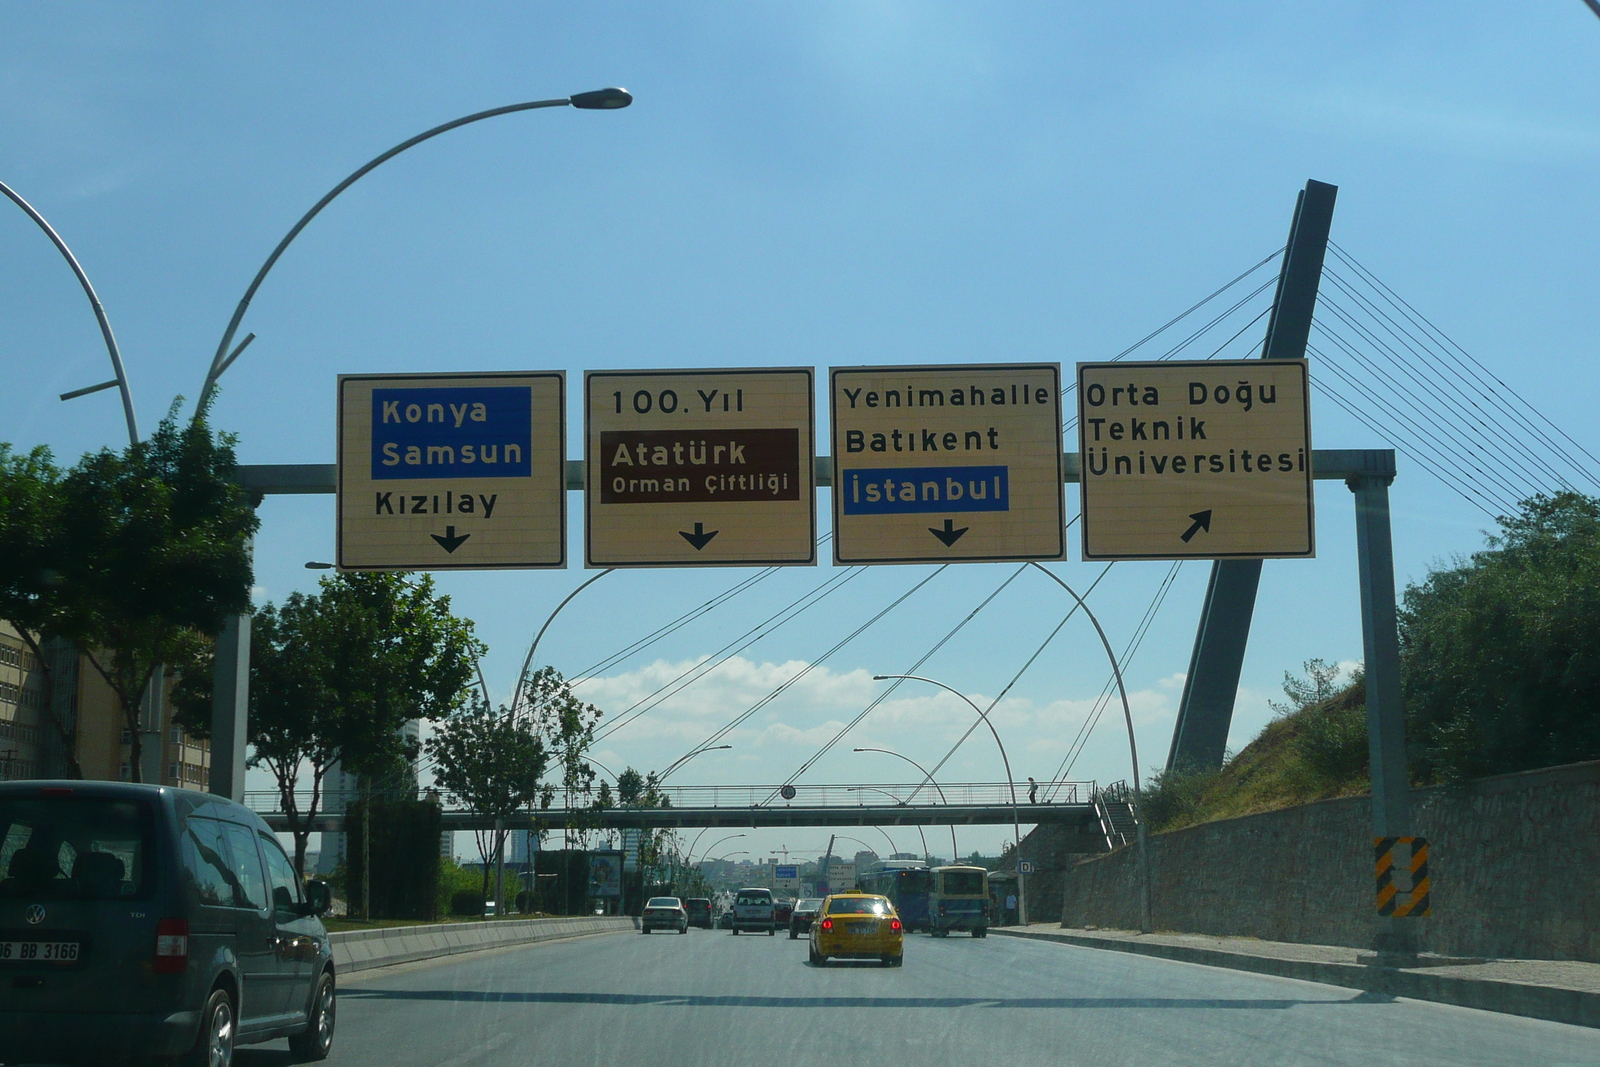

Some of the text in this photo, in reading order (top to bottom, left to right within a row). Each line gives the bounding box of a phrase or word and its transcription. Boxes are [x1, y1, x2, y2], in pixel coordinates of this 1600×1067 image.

[842, 384, 1049, 409] Yenimahalle
[1086, 380, 1276, 413] Orta Doğu
[382, 400, 487, 428] Konya
[846, 427, 999, 453] Batıkent
[1087, 415, 1207, 442] Teknik
[381, 442, 522, 466] Samsun
[611, 440, 747, 467] Atatürk
[1088, 446, 1305, 476] Üniversitesi
[612, 472, 788, 495] Orman Çiftliği
[852, 474, 1001, 503] İstanbul
[375, 490, 498, 519] Kızılay
[1022, 863, 1030, 871] D
[129, 911, 146, 919] TDI
[20, 943, 38, 959] BB
[43, 943, 78, 959] 3166
